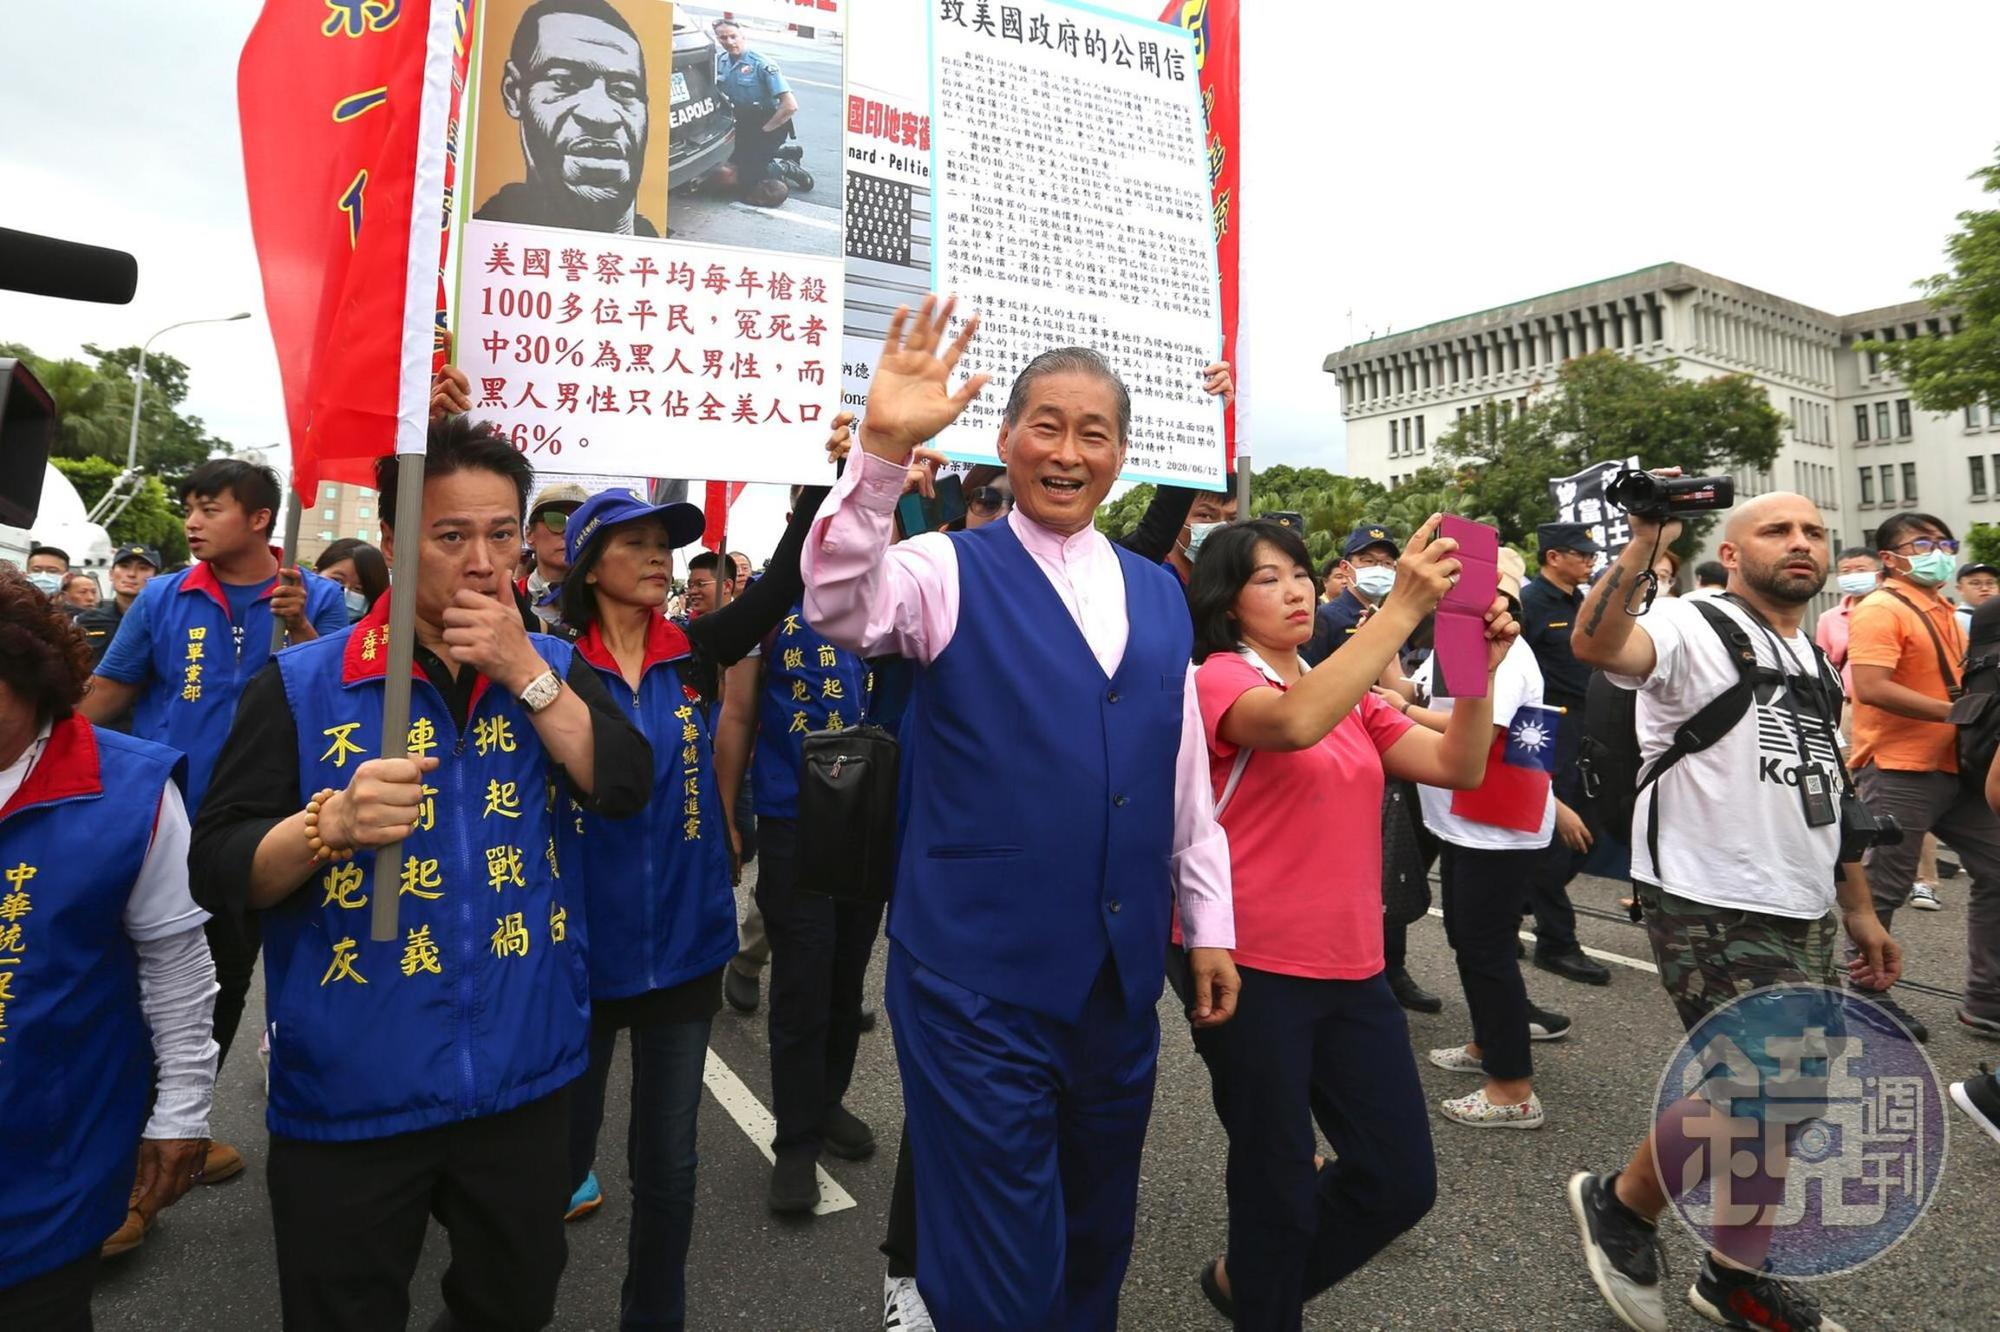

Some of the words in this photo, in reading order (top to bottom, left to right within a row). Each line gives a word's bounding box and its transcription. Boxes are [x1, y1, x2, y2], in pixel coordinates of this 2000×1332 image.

[941, 0, 1185, 82] 致美國政府的公開信
[889, 153, 931, 177] Peltie
[484, 243, 829, 303] 美國警察平均每年槍殺
[480, 287, 828, 347] 1000多位平民，冤死者
[482, 330, 825, 386] 中30%為黑人男性，而
[477, 377, 823, 425] 黑人男性只佔全美人口
[1128, 413, 1215, 435] 訴求予以正面回應
[1166, 460, 1218, 477] 2020/06/12
[182, 626, 207, 702] 田單黨部
[782, 614, 812, 735] 不做炮灰
[673, 704, 702, 841] 中華統一促進黨
[1759, 756, 1840, 796] Kok
[320, 722, 368, 987] 不炮灰
[473, 714, 529, 958] 挑起戰禍
[0, 862, 38, 1048] 中華統一促
